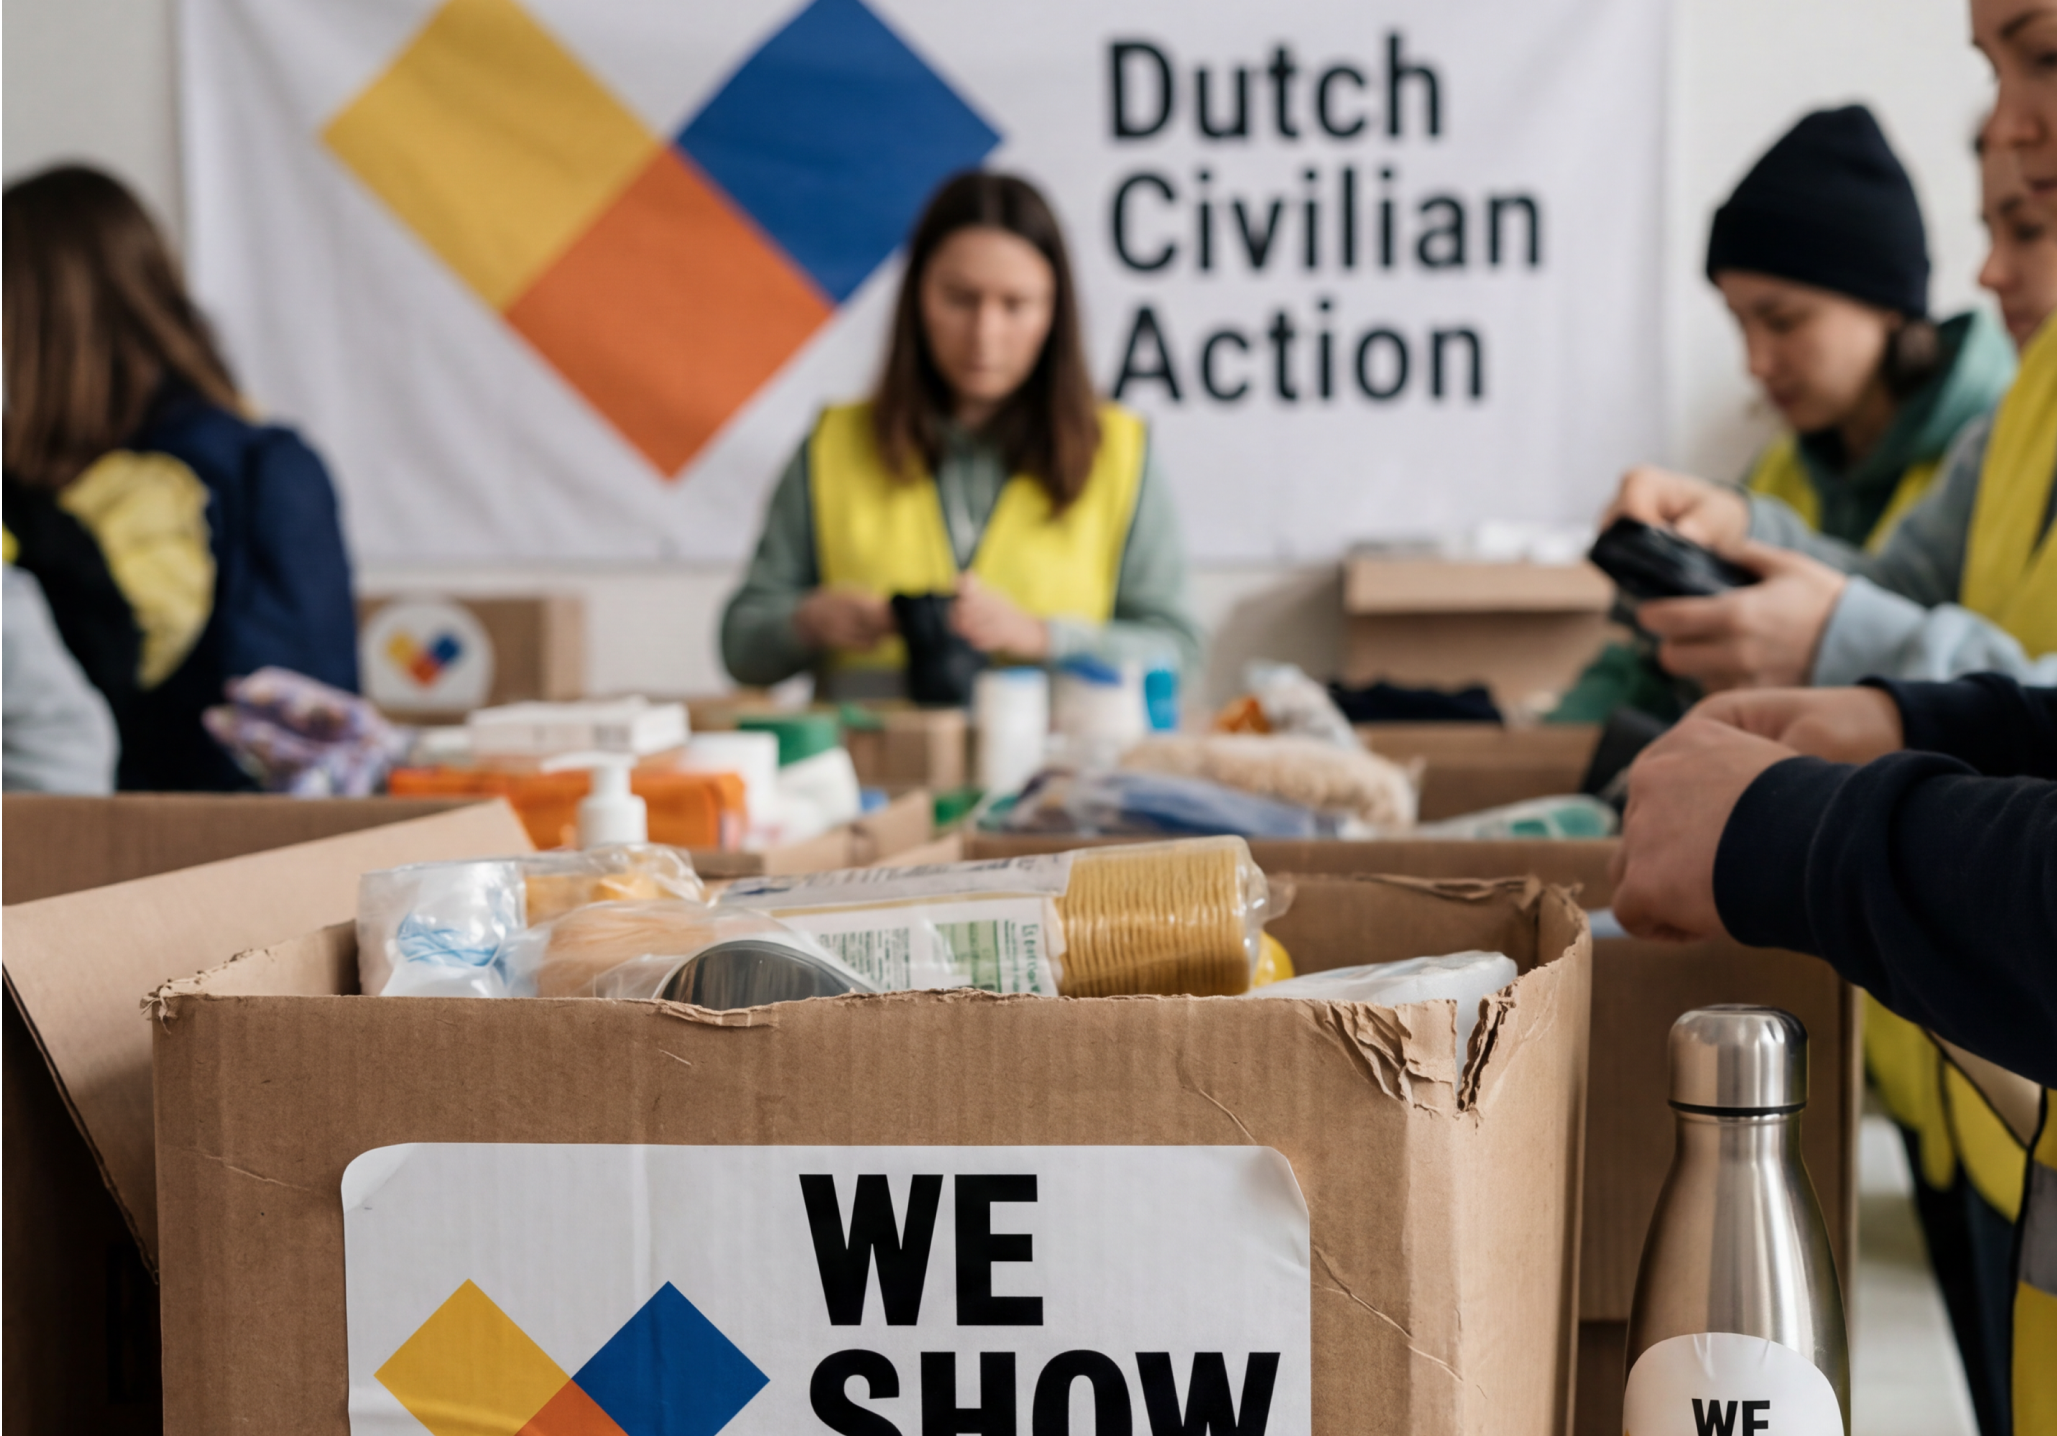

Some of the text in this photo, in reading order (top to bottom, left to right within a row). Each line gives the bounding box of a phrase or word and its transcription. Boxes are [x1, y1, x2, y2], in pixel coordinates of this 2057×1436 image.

[1108, 29, 1442, 141] Dutch
[1110, 164, 1541, 273] Civilian
[1113, 295, 1484, 403] Action
[799, 1174, 1044, 1326] WE
[810, 1349, 1281, 1436] SHOW
[1691, 1398, 1770, 1436] WE
